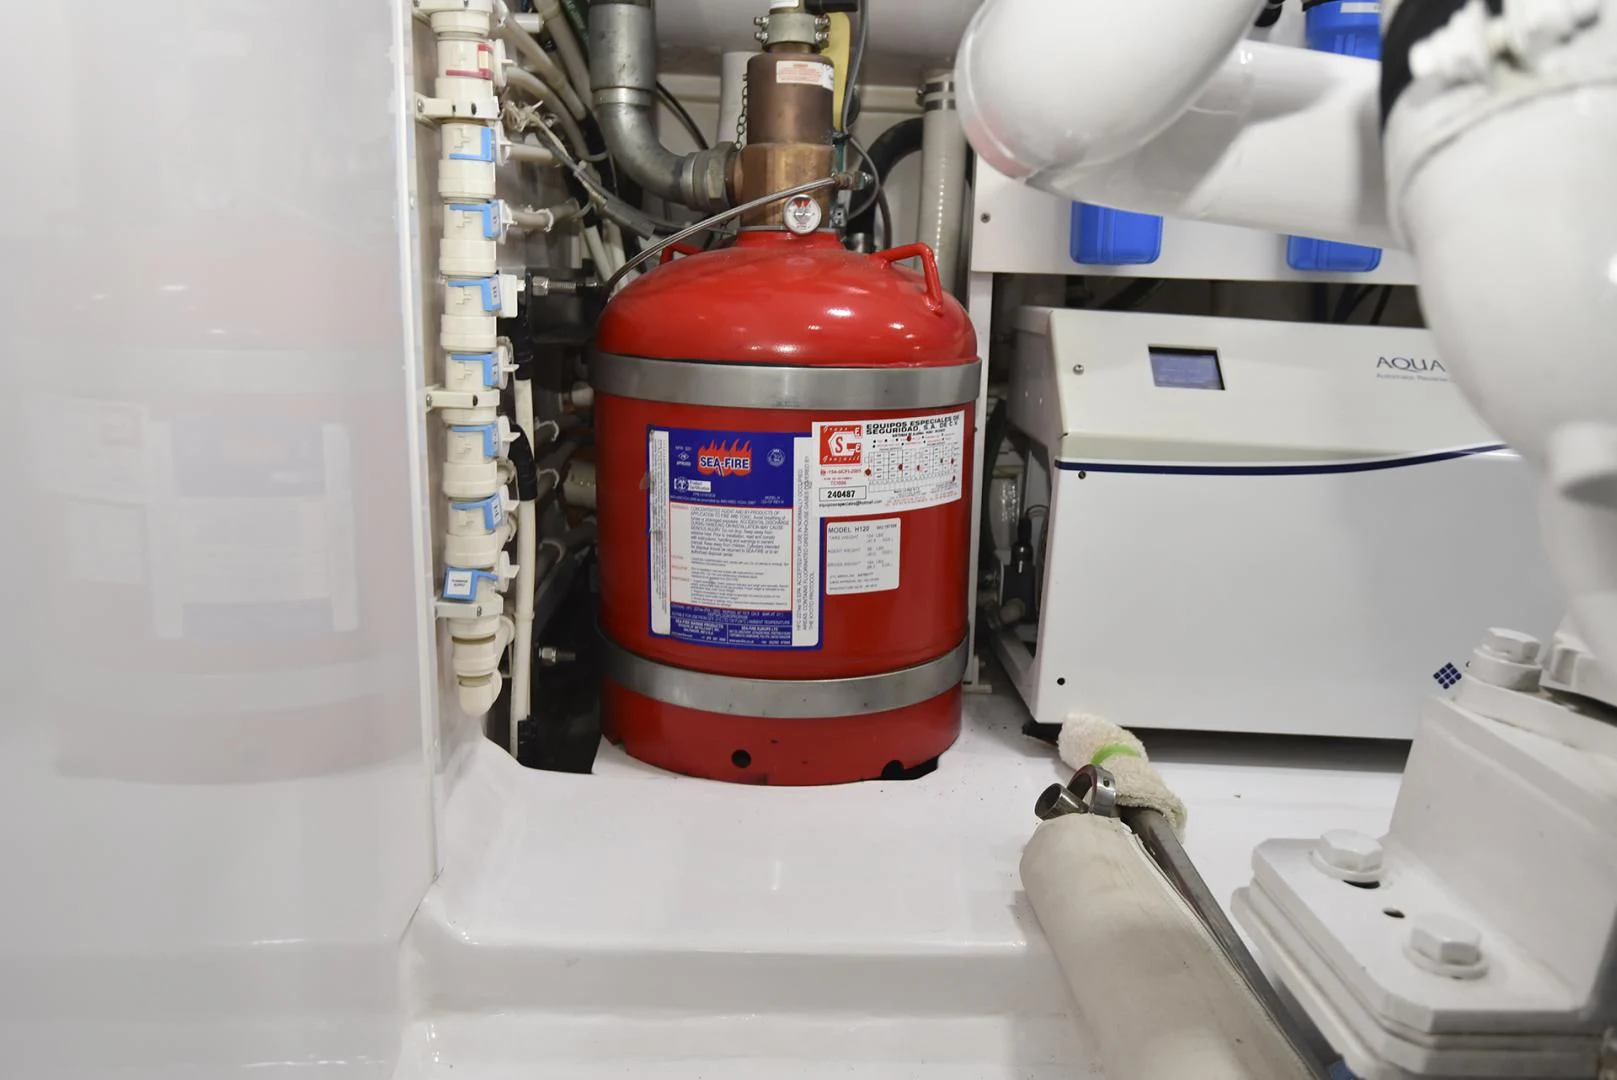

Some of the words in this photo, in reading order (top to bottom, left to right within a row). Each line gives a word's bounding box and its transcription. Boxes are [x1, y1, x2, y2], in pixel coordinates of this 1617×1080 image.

[1376, 356, 1446, 372] AQUA
[866, 421, 908, 430] EQUIPOS
[910, 415, 952, 426] ESPECIALES
[700, 456, 751, 471] SEA-FIRE
[827, 490, 856, 499] 240487
